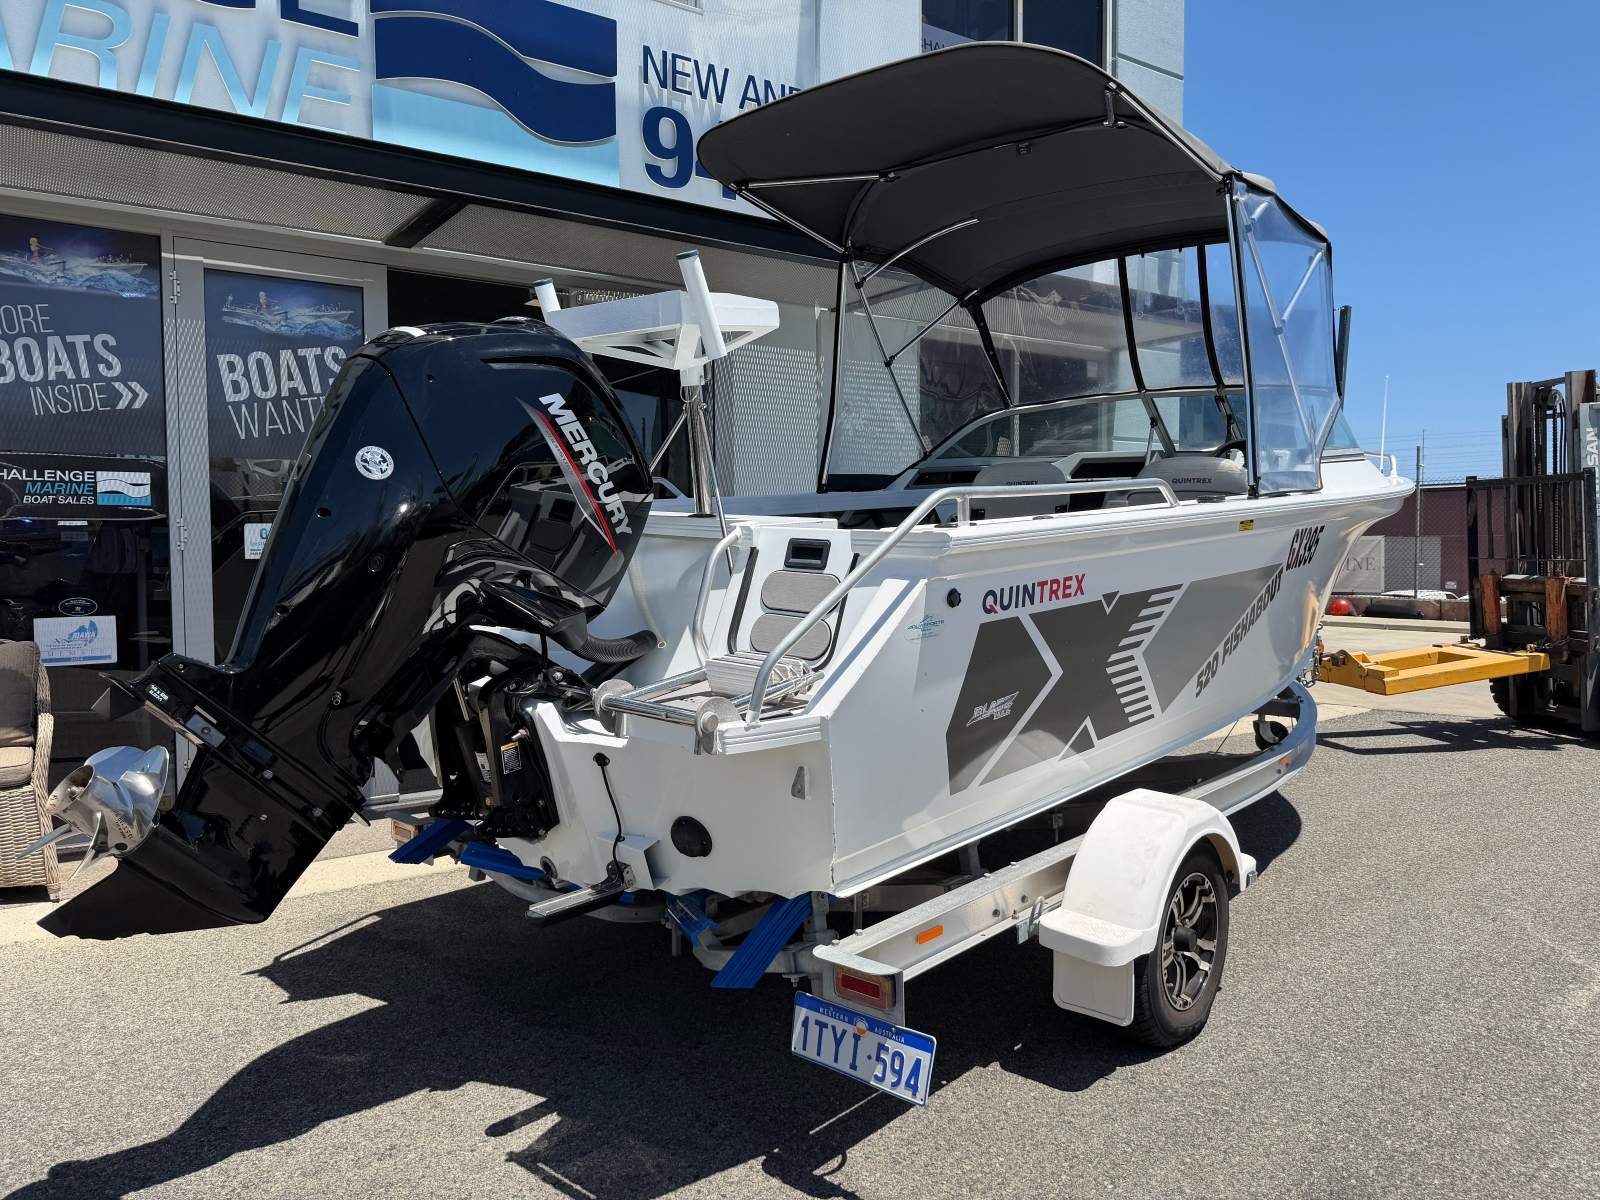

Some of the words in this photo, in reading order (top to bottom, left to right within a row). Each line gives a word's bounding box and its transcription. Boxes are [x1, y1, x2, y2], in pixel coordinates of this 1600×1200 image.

[0, 0, 361, 136] RINE
[642, 44, 730, 105] NEW
[738, 74, 802, 110] AN
[642, 106, 738, 202] 9
[0, 303, 54, 335] ORE
[30, 382, 111, 416] INSIDE
[228, 395, 327, 440] WANT
[538, 392, 633, 535] MERCURY
[1172, 477, 1213, 485] QUINTREX
[23, 495, 55, 504] BOAT
[57, 496, 95, 505] SALES
[25, 481, 95, 496] MARINE
[982, 573, 1086, 615] QUINTREX
[1195, 651, 1220, 698] 520
[1221, 565, 1286, 666] FISHABOUT
[820, 1007, 849, 1023] WESTERN
[874, 1026, 906, 1044] AUSTRALIA
